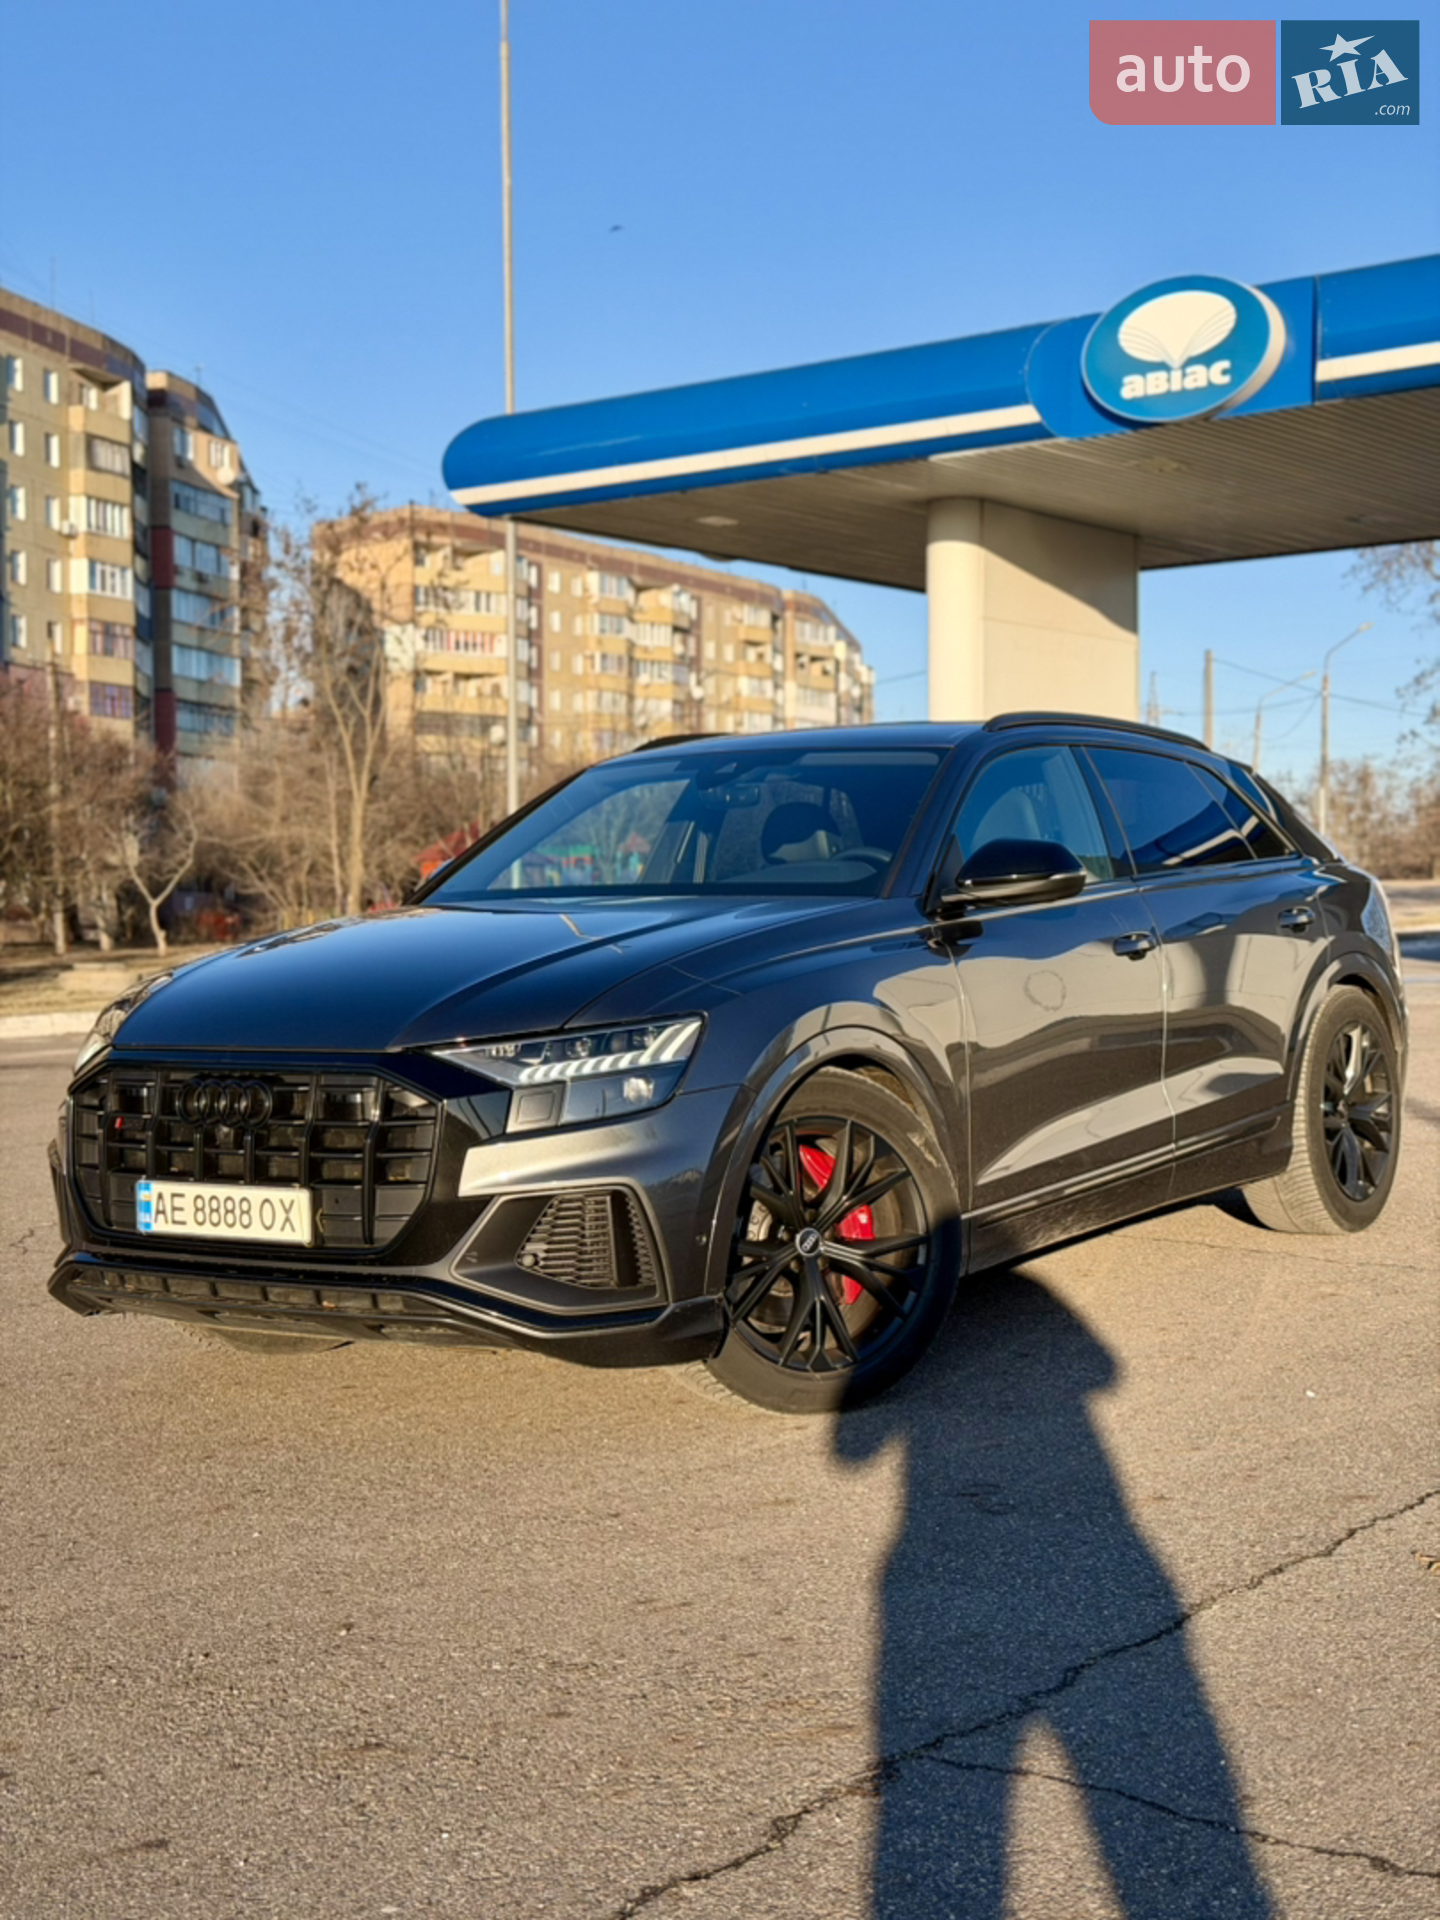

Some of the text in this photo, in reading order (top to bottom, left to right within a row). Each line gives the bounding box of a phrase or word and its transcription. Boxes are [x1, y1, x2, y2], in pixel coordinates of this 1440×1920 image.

[154, 1192, 296, 1233] AE 8888 OX
